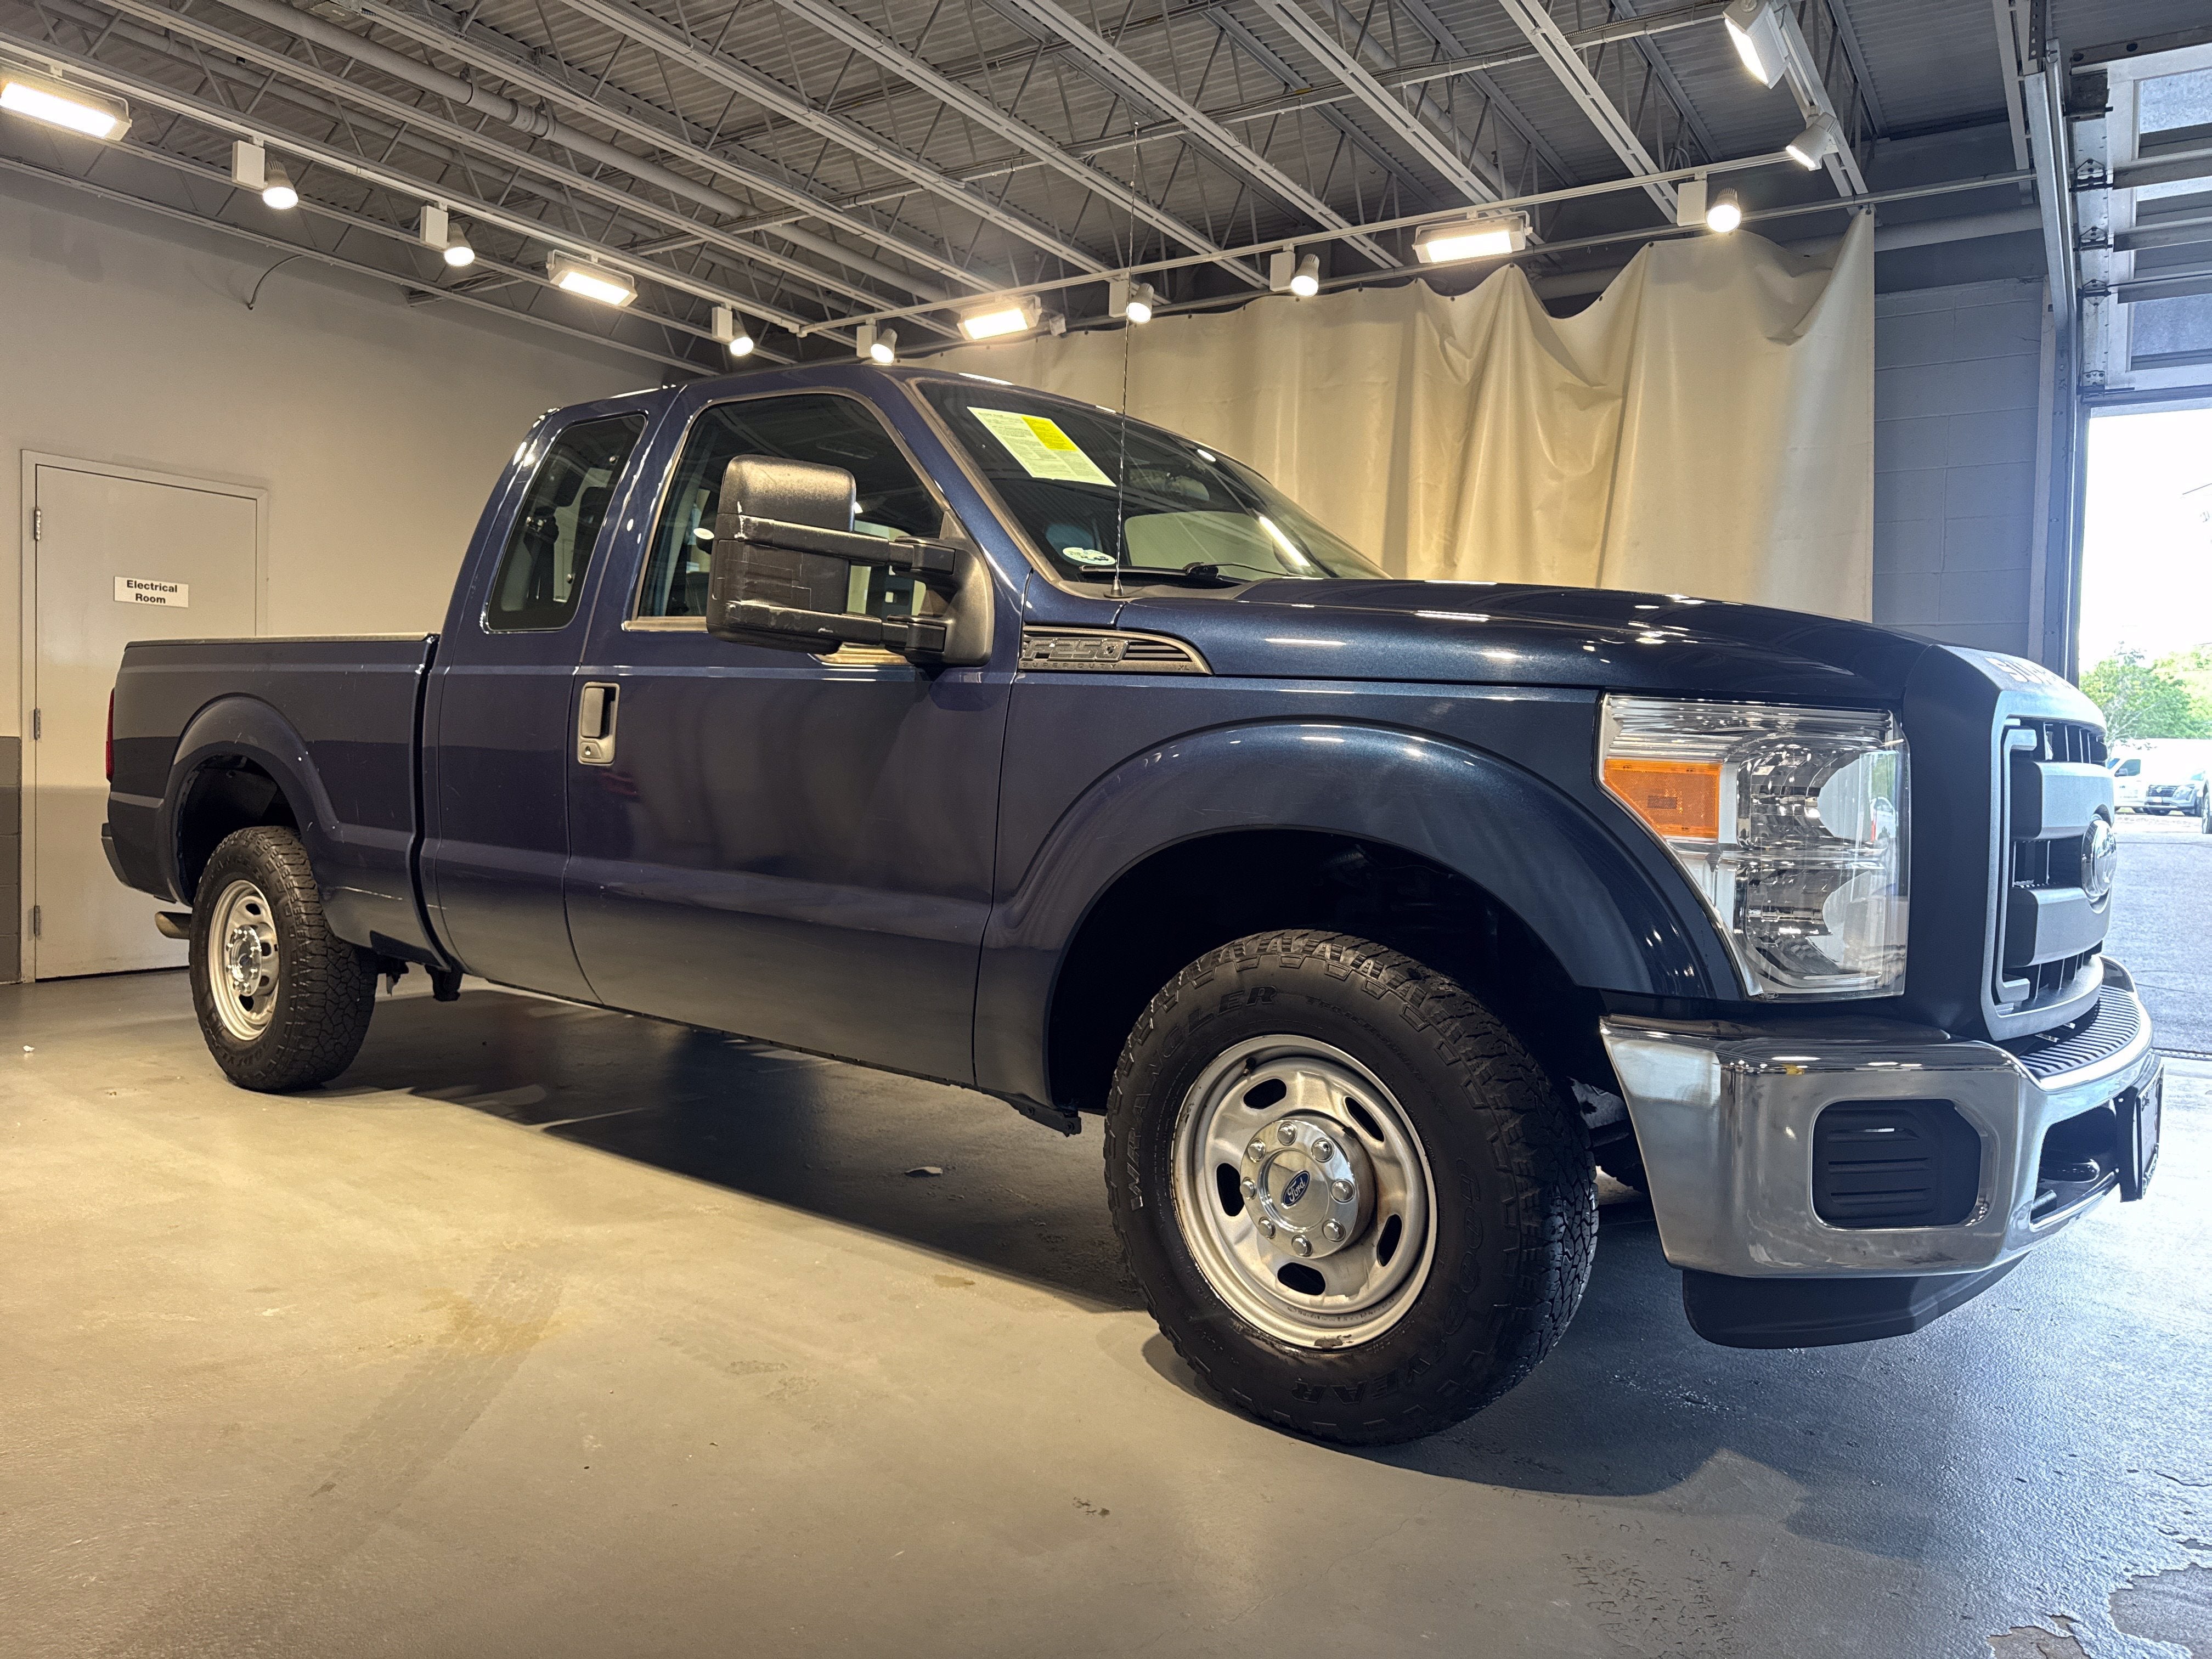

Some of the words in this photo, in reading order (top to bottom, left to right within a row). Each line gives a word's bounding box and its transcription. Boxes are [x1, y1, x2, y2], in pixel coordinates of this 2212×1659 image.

[127, 579, 178, 593] Electrical
[135, 593, 166, 604] Room
[1127, 985, 1278, 1211] WRANGLER
[1287, 1177, 1306, 1202] Ford
